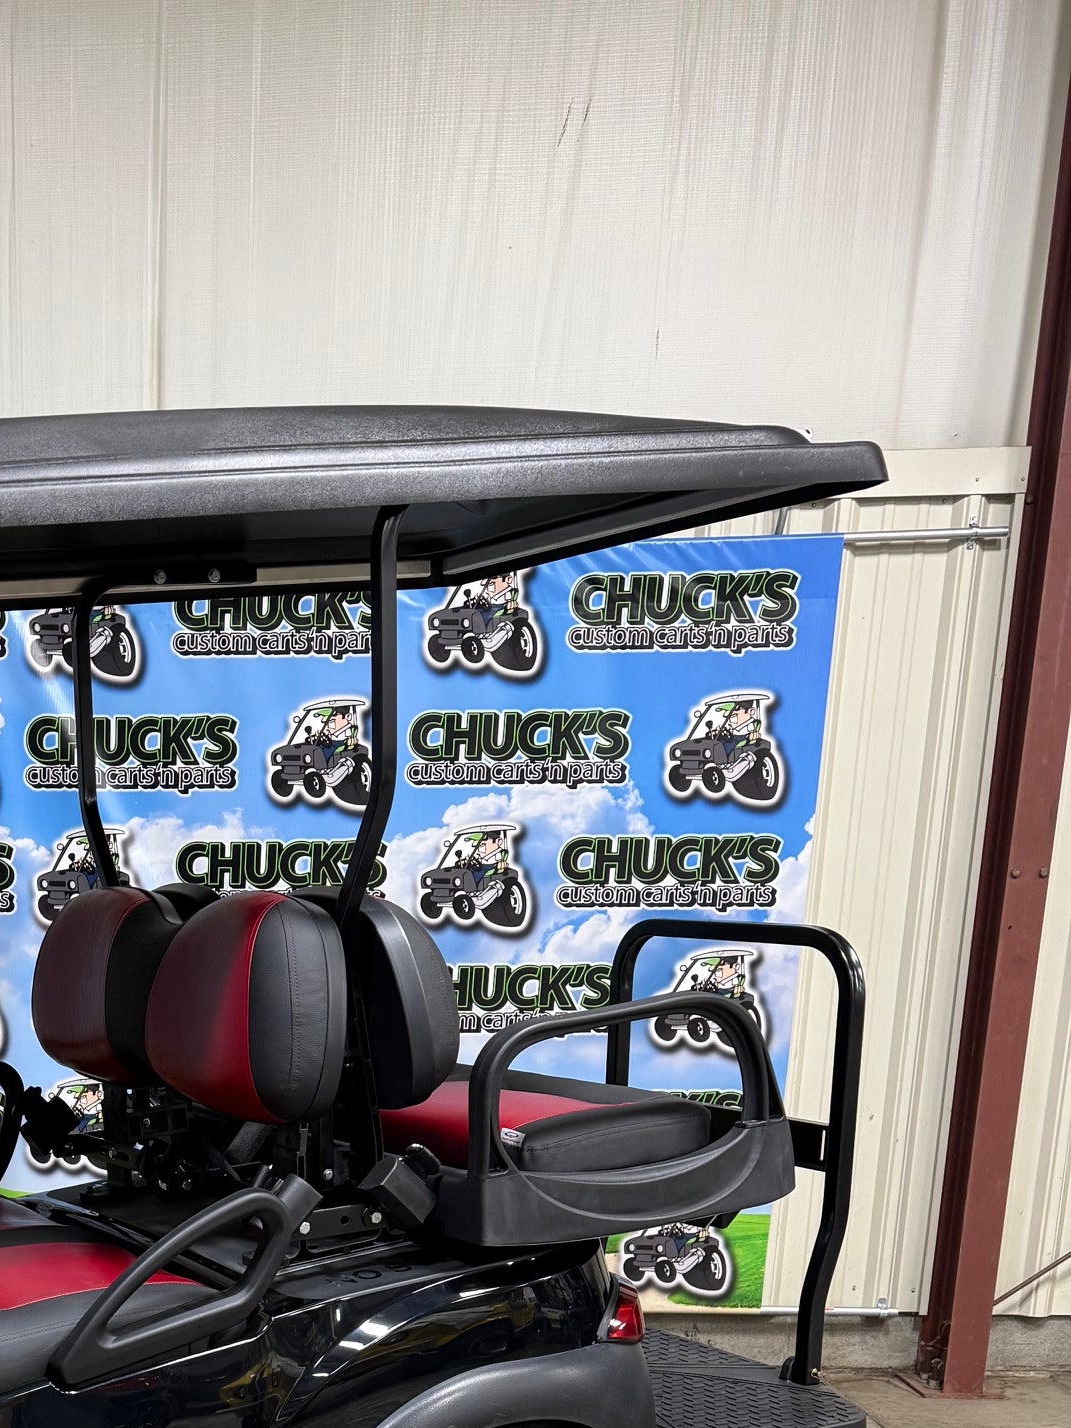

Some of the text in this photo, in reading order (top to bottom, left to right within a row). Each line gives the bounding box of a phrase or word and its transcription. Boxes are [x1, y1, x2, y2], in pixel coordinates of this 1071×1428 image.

[572, 571, 798, 624] CHUCK'S
[173, 631, 253, 652] custom
[332, 631, 371, 657] par
[570, 626, 650, 646] custom
[732, 624, 790, 650] parts
[409, 710, 630, 762] CHUCK'S
[26, 765, 101, 786] custo
[178, 764, 233, 791] parts
[407, 761, 488, 782] custom
[568, 760, 624, 788] parts
[559, 834, 781, 884] CHUCK'S
[557, 883, 638, 904] custom
[717, 882, 774, 910] parts
[448, 964, 613, 1012] HUCK'S
